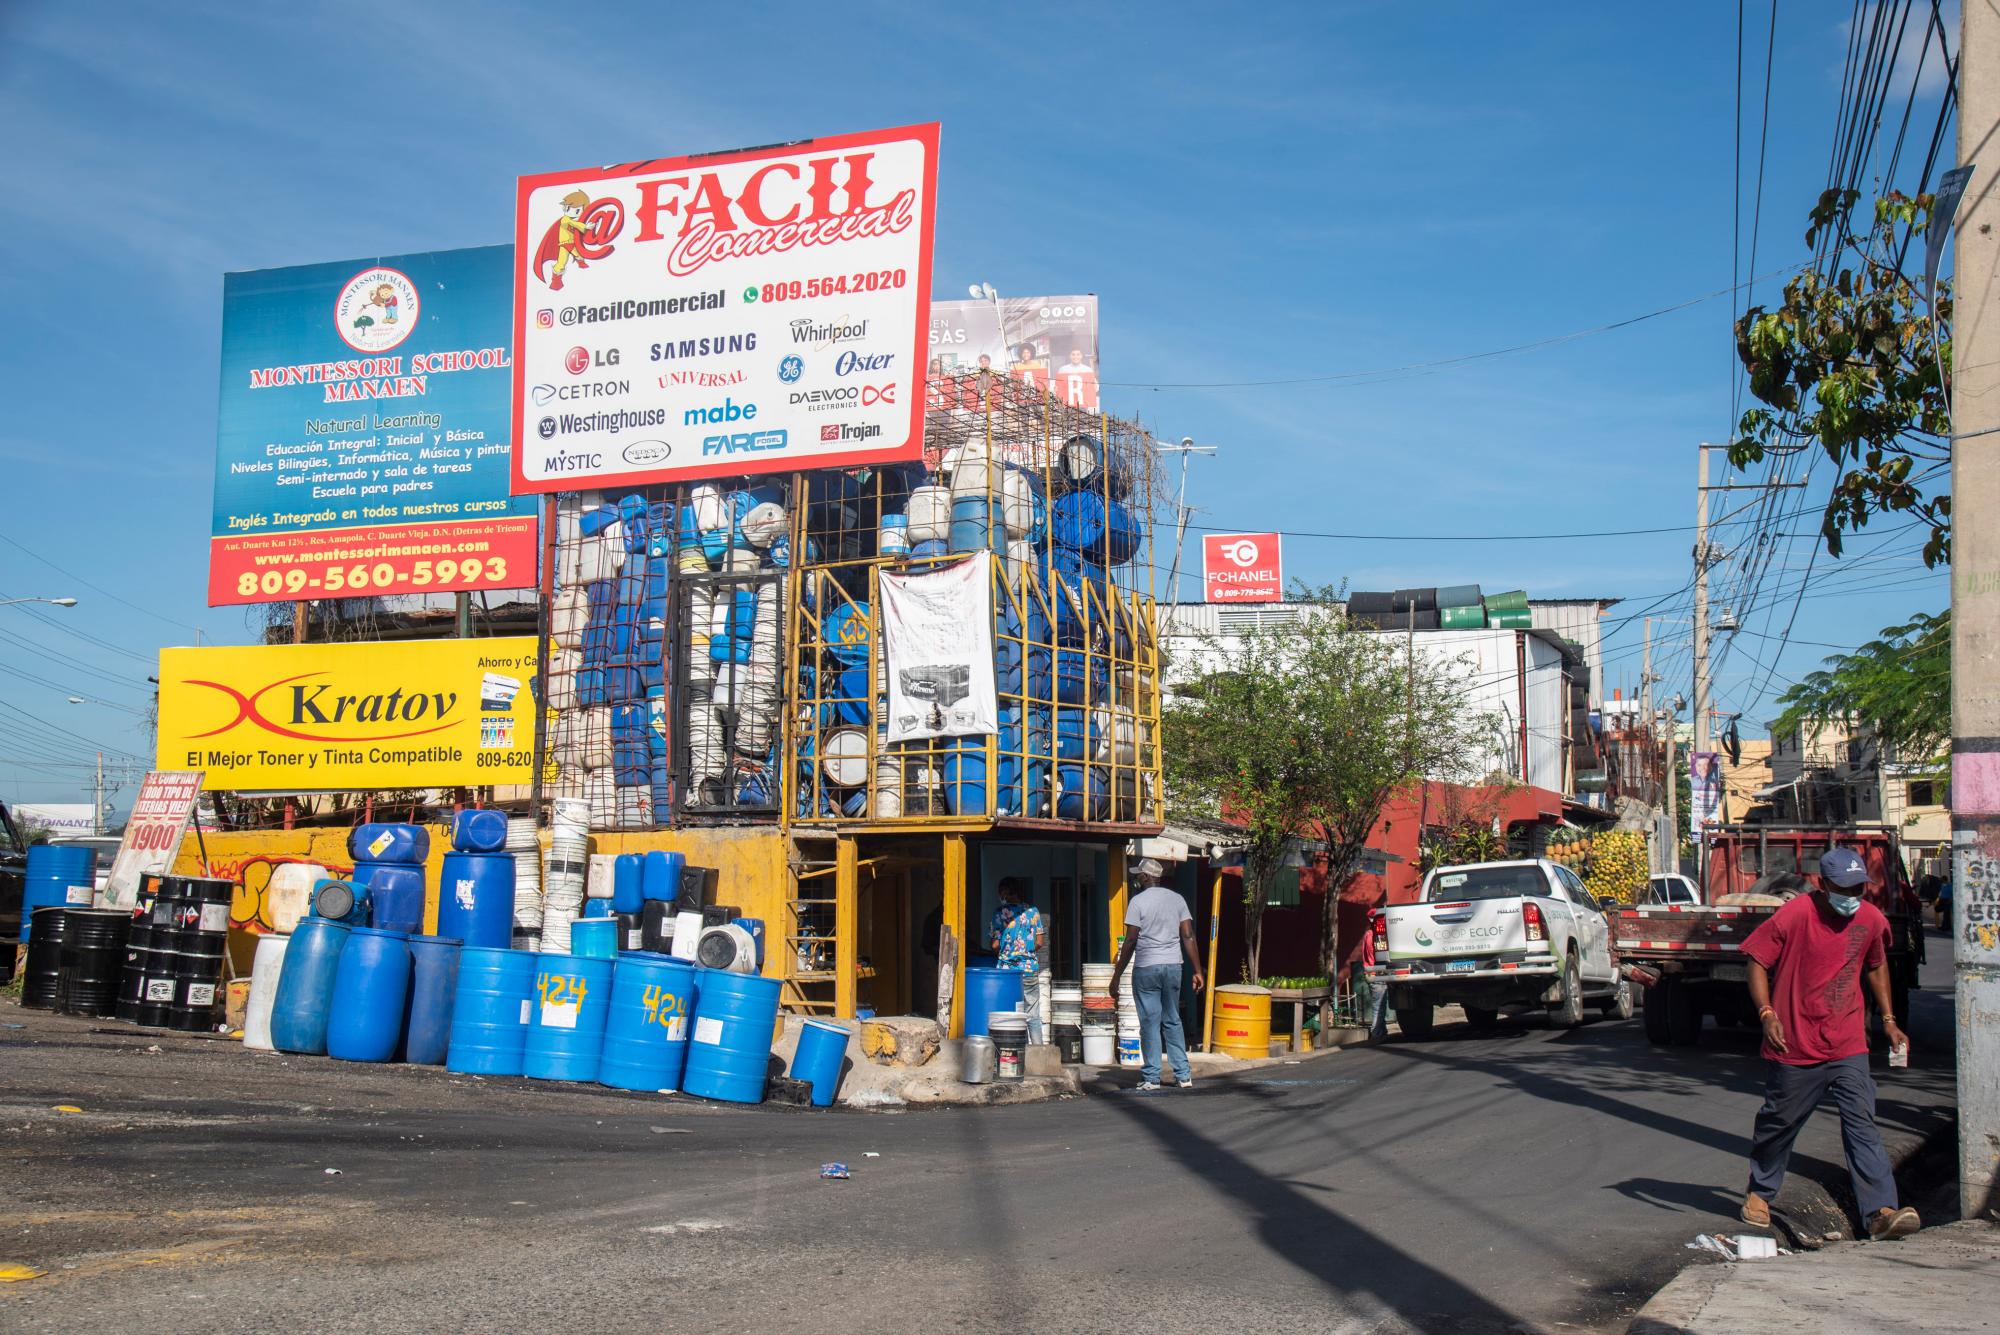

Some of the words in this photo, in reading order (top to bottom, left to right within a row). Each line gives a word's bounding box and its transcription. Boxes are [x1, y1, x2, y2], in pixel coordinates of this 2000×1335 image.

[634, 153, 905, 242] FACIL
[667, 189, 915, 277] Comercial
[341, 273, 387, 317] MONTESSORI
[388, 275, 415, 311] MANAEN
[761, 268, 906, 304] 809.564.2020
[560, 289, 725, 327] @FacilComercial
[595, 348, 620, 367] LG
[650, 332, 757, 362] SAMSUNG
[791, 319, 866, 344] Whirlpool
[249, 356, 402, 389] MONTESSORI
[412, 347, 511, 375] SCHOOL
[558, 380, 630, 400] CETRON
[658, 369, 748, 389] UNIVERSAL
[835, 350, 895, 377] Oster
[323, 375, 428, 403] MANAEN
[560, 408, 665, 434] Westinghouse
[684, 397, 757, 426] mabe
[789, 386, 859, 405] DAEWOO
[808, 401, 858, 412] ELECTRONICS
[305, 414, 367, 436] Natural
[373, 411, 441, 430] Learning
[266, 440, 323, 456] Educación
[327, 436, 381, 452] Integral:
[386, 432, 424, 446] Inicial
[433, 433, 441, 446] y
[446, 429, 484, 442] Básica
[544, 449, 602, 473] MYSTIC
[840, 421, 881, 441] Trojan
[231, 460, 273, 474] Niveles
[278, 457, 332, 471] Bilingües,
[337, 450, 413, 465] Informática,
[419, 447, 460, 460] Música
[465, 447, 472, 459] y
[276, 468, 368, 486] Semi-internado
[372, 469, 380, 482] y
[384, 464, 408, 477] sala
[413, 464, 428, 475] de
[432, 463, 472, 474] tareas
[312, 484, 357, 499] Escuela
[361, 484, 388, 498] para
[393, 480, 434, 495] padres
[228, 513, 268, 530] Inglés
[272, 508, 337, 526] Integrado
[341, 509, 357, 519] en
[362, 505, 398, 518] todos
[403, 502, 459, 515] nuestros
[464, 499, 507, 512] cursos
[224, 542, 241, 551] Aut.
[242, 541, 269, 550] Duarte
[271, 539, 286, 548] Km
[310, 536, 327, 545] Res.
[328, 533, 366, 544] Amapola,
[367, 532, 377, 541] C.
[378, 530, 406, 540] Duarte
[433, 527, 451, 537] D.N.
[453, 525, 483, 537] (Detras
[484, 524, 494, 534] de
[495, 523, 528, 533] Tricom)
[255, 541, 489, 566] www.montessorimanaen.com
[237, 556, 507, 596] 809-560-5993
[1208, 570, 1278, 583] FCHANEL
[478, 656, 512, 668] Ahorro
[514, 659, 521, 669] y
[288, 684, 457, 724] Kratov
[187, 751, 202, 767] El
[208, 751, 253, 769] Mejor
[258, 750, 304, 766] Toner
[308, 753, 318, 768] y
[323, 749, 363, 765] Tinta
[369, 746, 462, 766] Compatible
[141, 786, 164, 799] TODO
[163, 786, 183, 799] TIPO
[181, 786, 195, 799] DE
[131, 824, 176, 851] 1900
[1469, 926, 1505, 938] ECLOF
[537, 972, 588, 1014] 424
